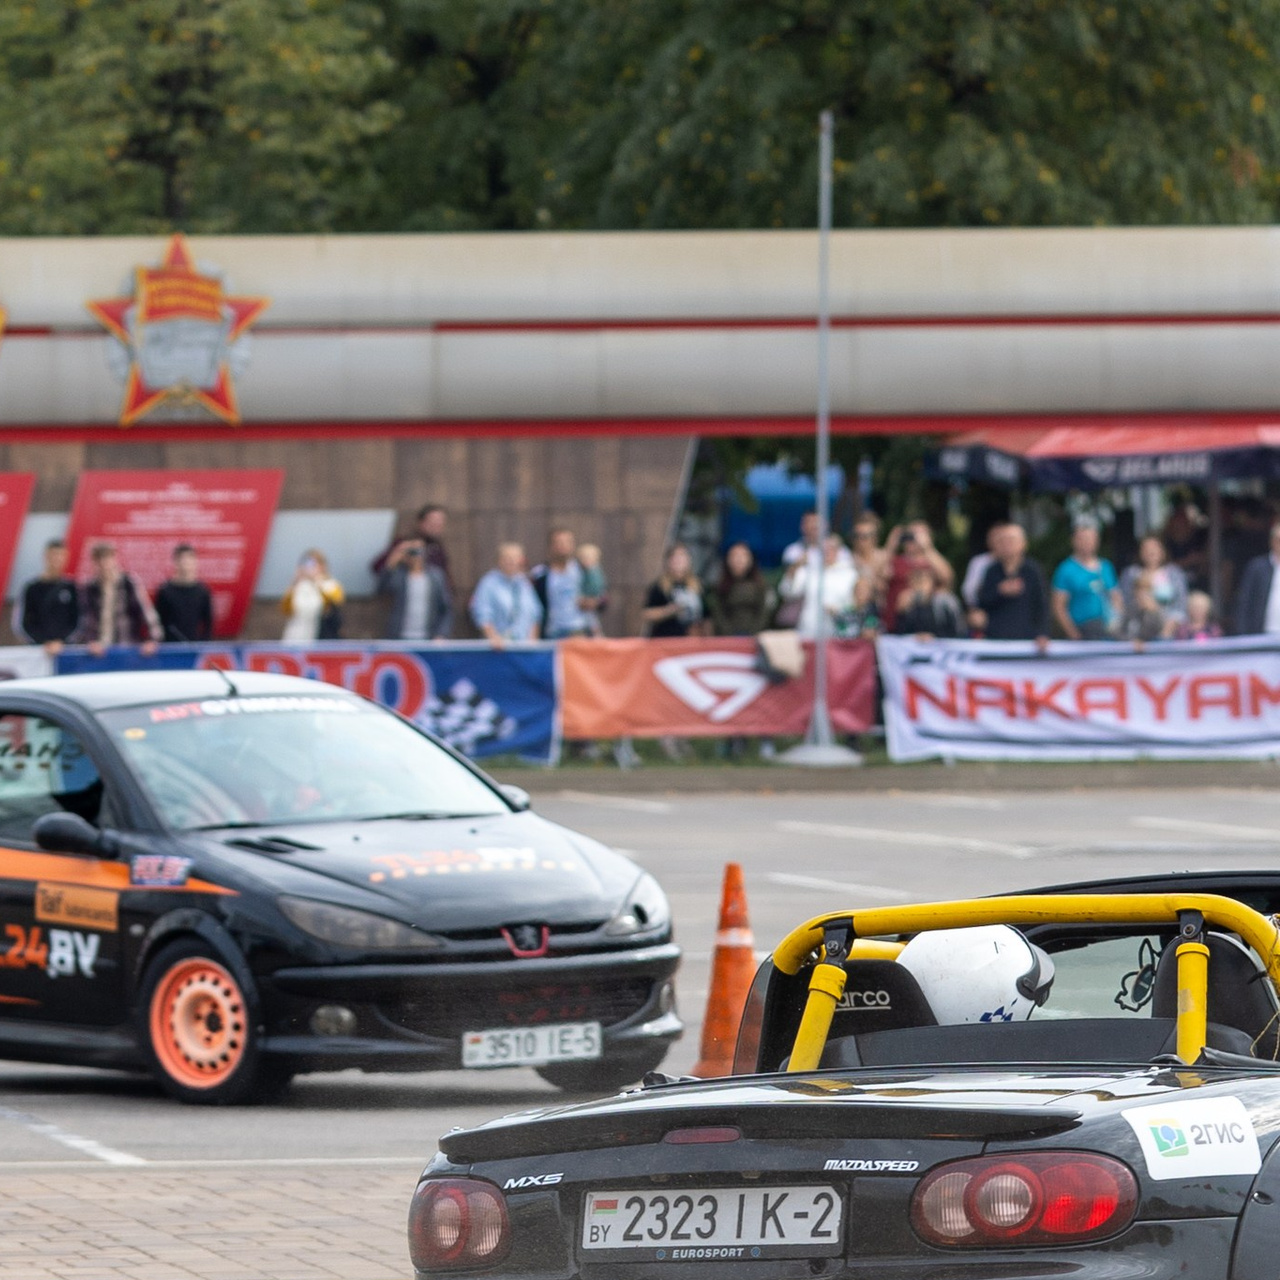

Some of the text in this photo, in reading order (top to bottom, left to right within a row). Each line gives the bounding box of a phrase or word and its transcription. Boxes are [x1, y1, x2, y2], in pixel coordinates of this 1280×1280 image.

[837, 990, 890, 1008] arco
[486, 1031, 537, 1059] 3510
[548, 1025, 596, 1055] IE-5
[1190, 1122, 1245, 1145] 2ГИС
[823, 1159, 919, 1172] MAZDASPEED
[503, 1172, 565, 1190] MX5
[622, 1195, 719, 1242] 2323
[589, 1225, 611, 1243] BY
[672, 1247, 744, 1259] EUROSPORT
